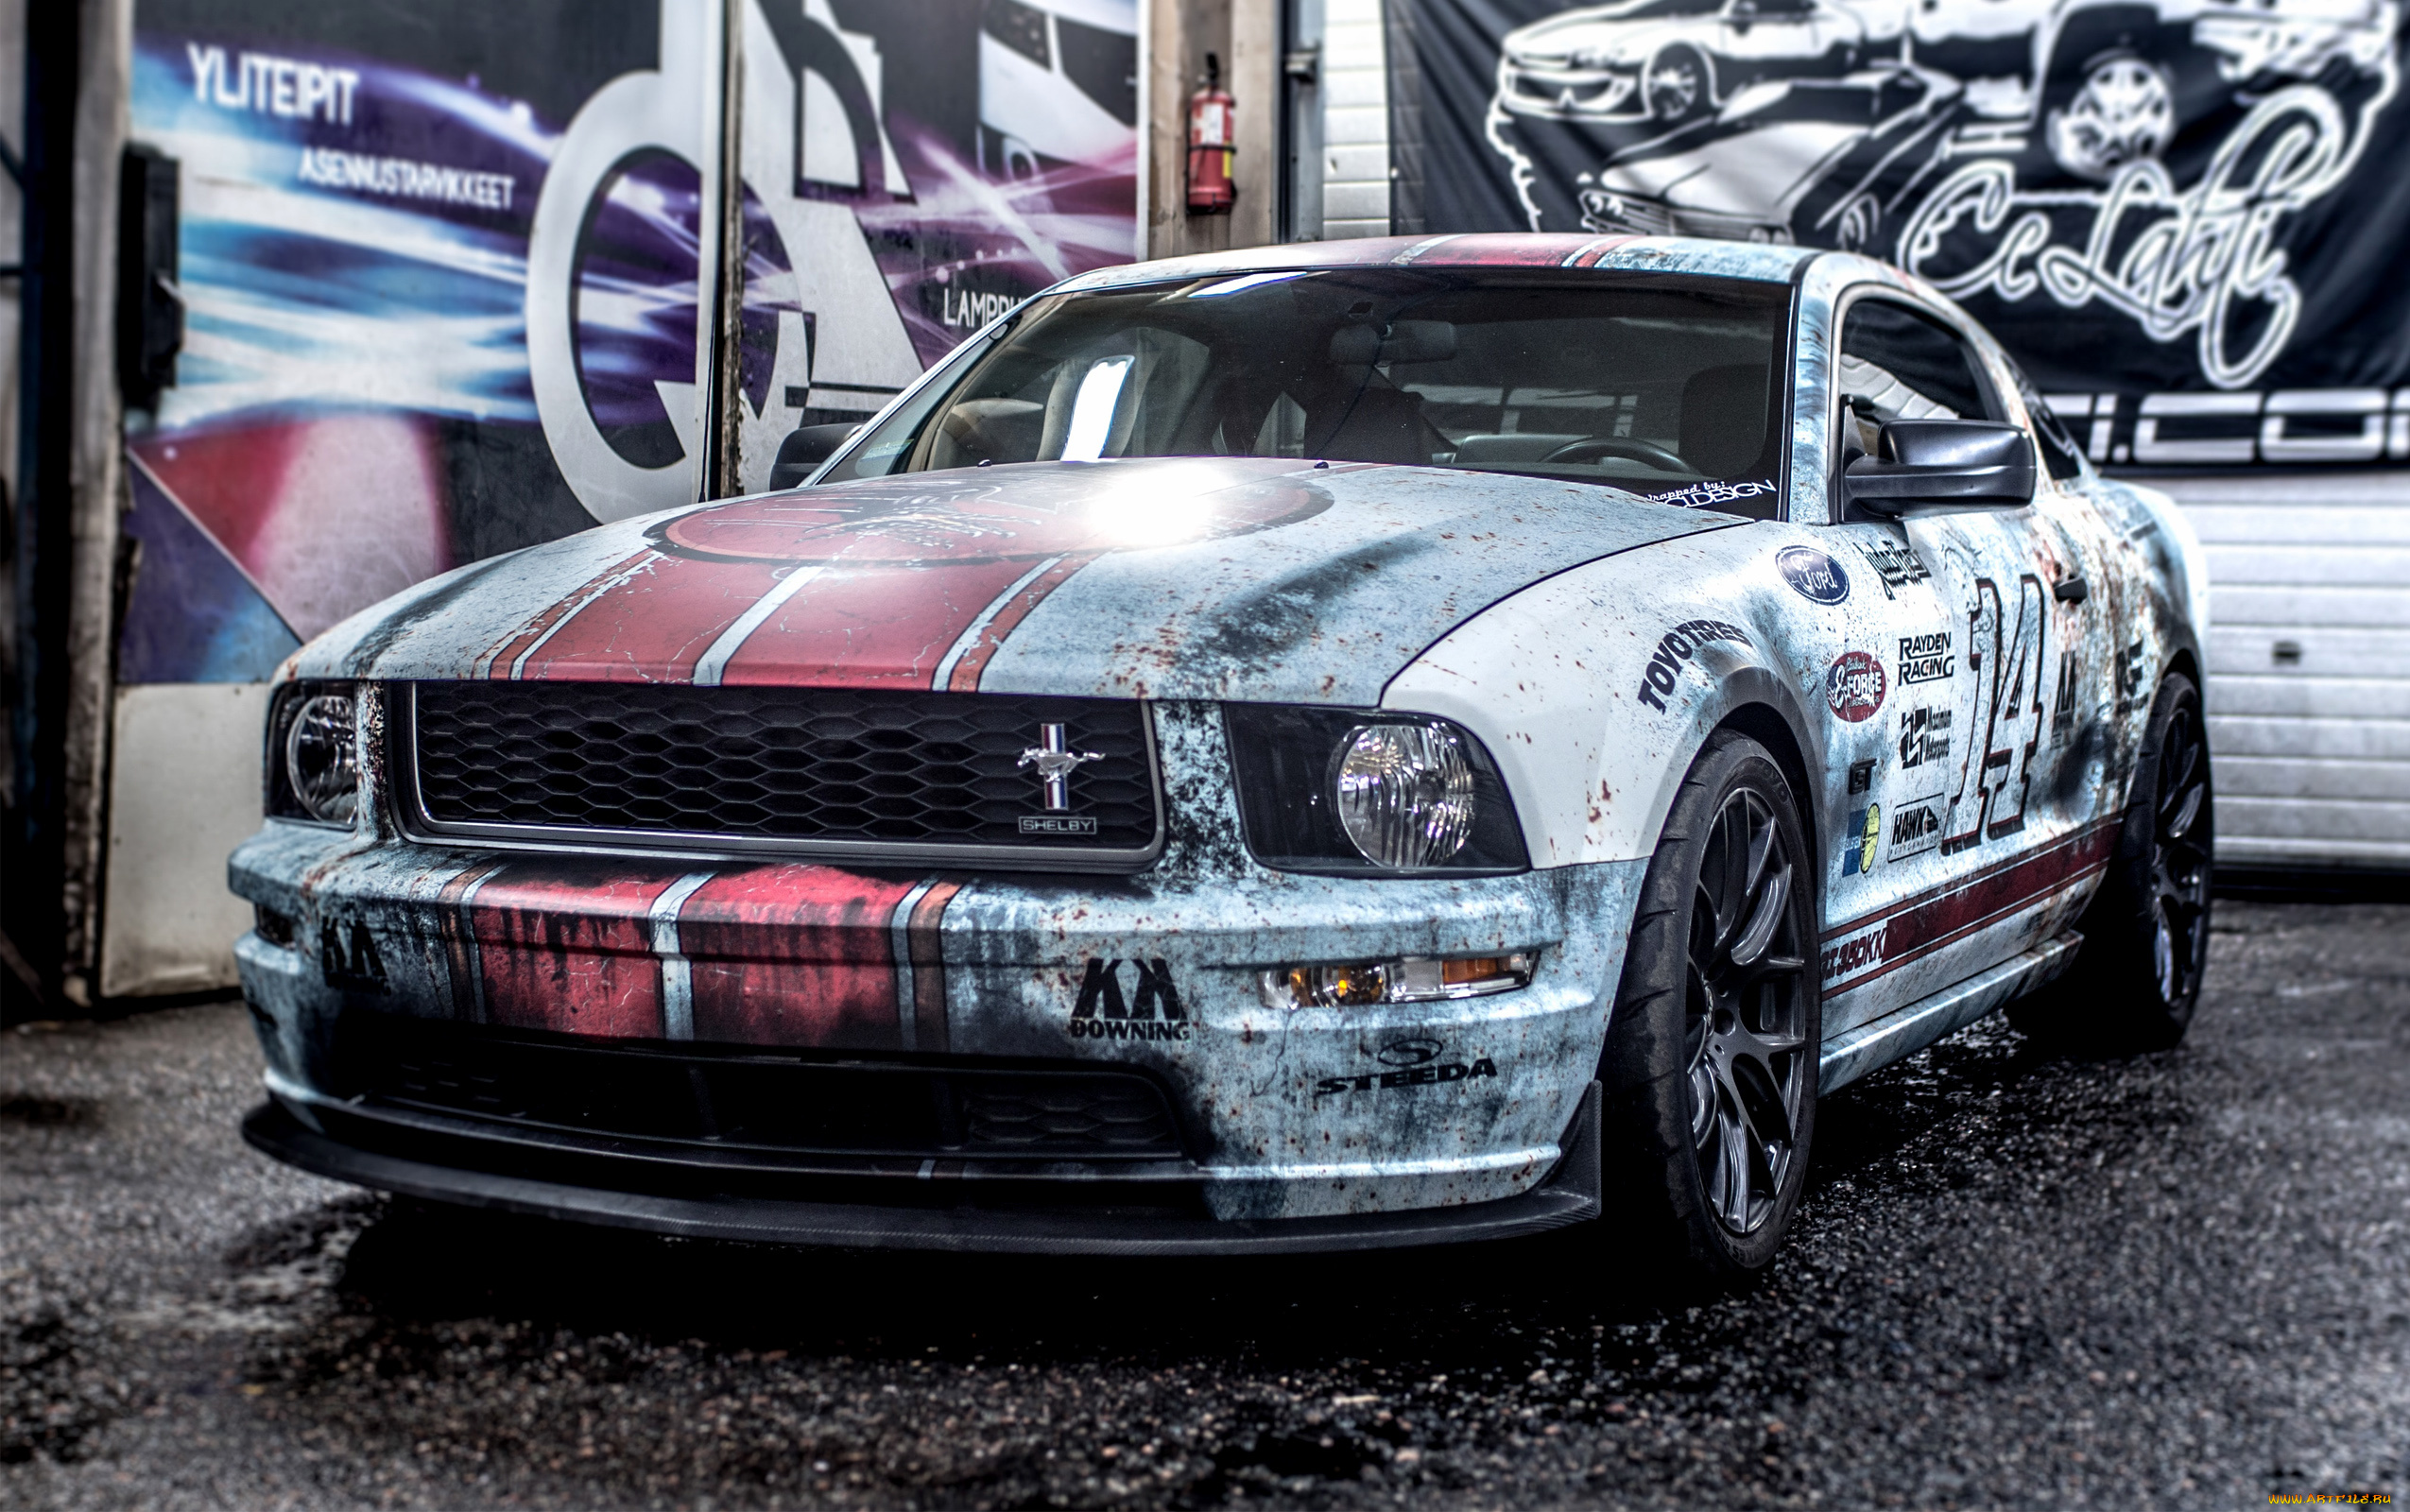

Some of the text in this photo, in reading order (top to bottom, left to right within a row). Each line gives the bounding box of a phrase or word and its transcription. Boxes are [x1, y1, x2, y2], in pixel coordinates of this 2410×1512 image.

[1789, 552, 1839, 593] Ford
[1898, 631, 1952, 662] RAYDEN
[1637, 619, 1754, 715] TOYO TIRES
[1897, 655, 1955, 686] RACING
[1941, 573, 2044, 856] 14
[1023, 819, 1092, 831] SHELBY
[1891, 805, 1928, 847] HAWK
[1069, 1019, 1191, 1041] DOWNING
[1313, 1057, 1498, 1097] STEEDA
